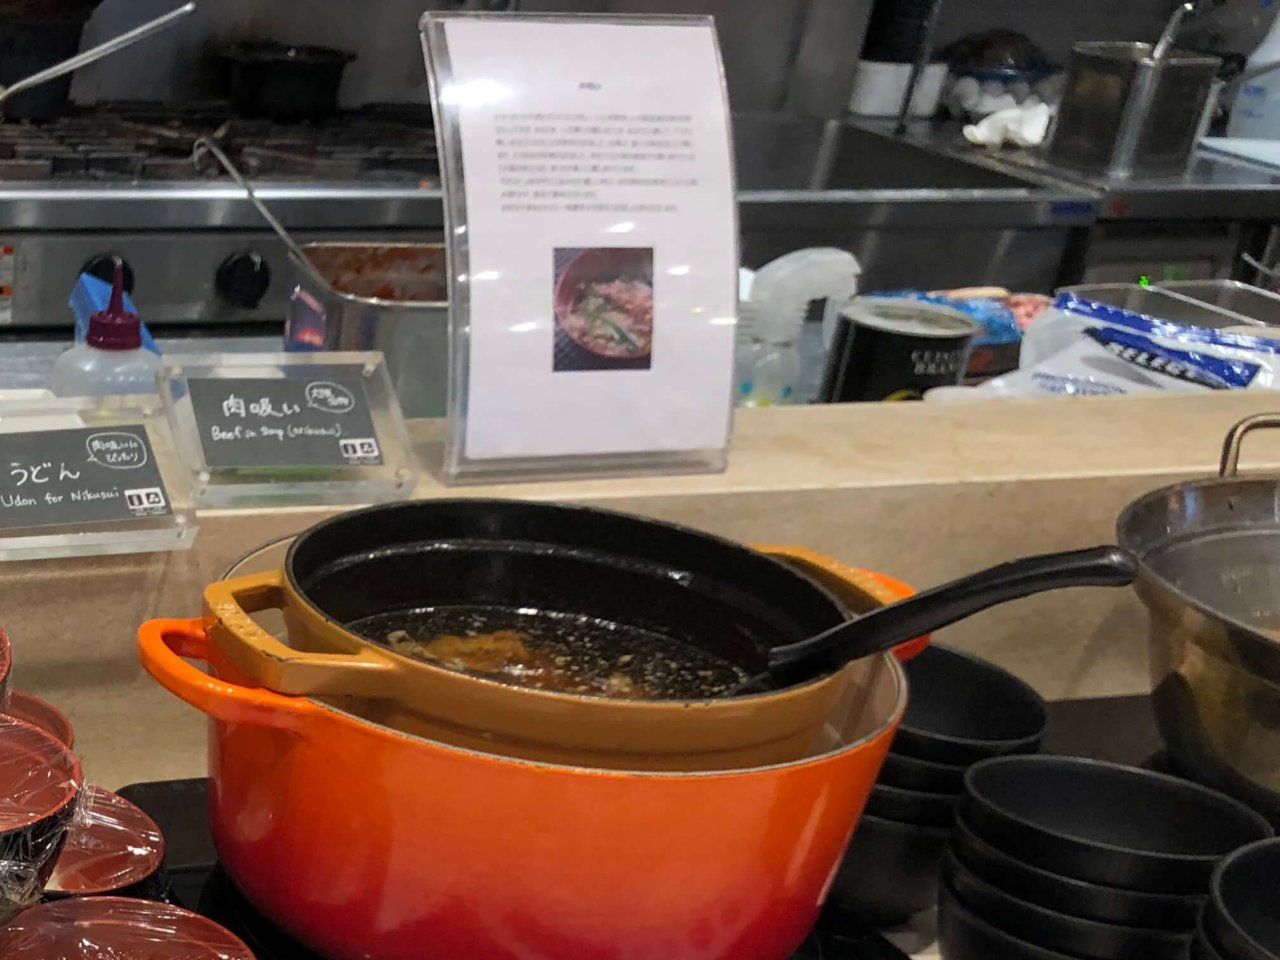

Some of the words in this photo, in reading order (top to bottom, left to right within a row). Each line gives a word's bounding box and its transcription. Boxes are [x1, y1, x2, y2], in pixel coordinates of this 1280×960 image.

[223, 394, 300, 417] 肉吸い
[211, 425, 241, 441] Beef
[9, 462, 81, 486] うどん
[0, 494, 37, 507] Udon
[44, 492, 64, 505] for
[71, 486, 119, 501] Nikusui
